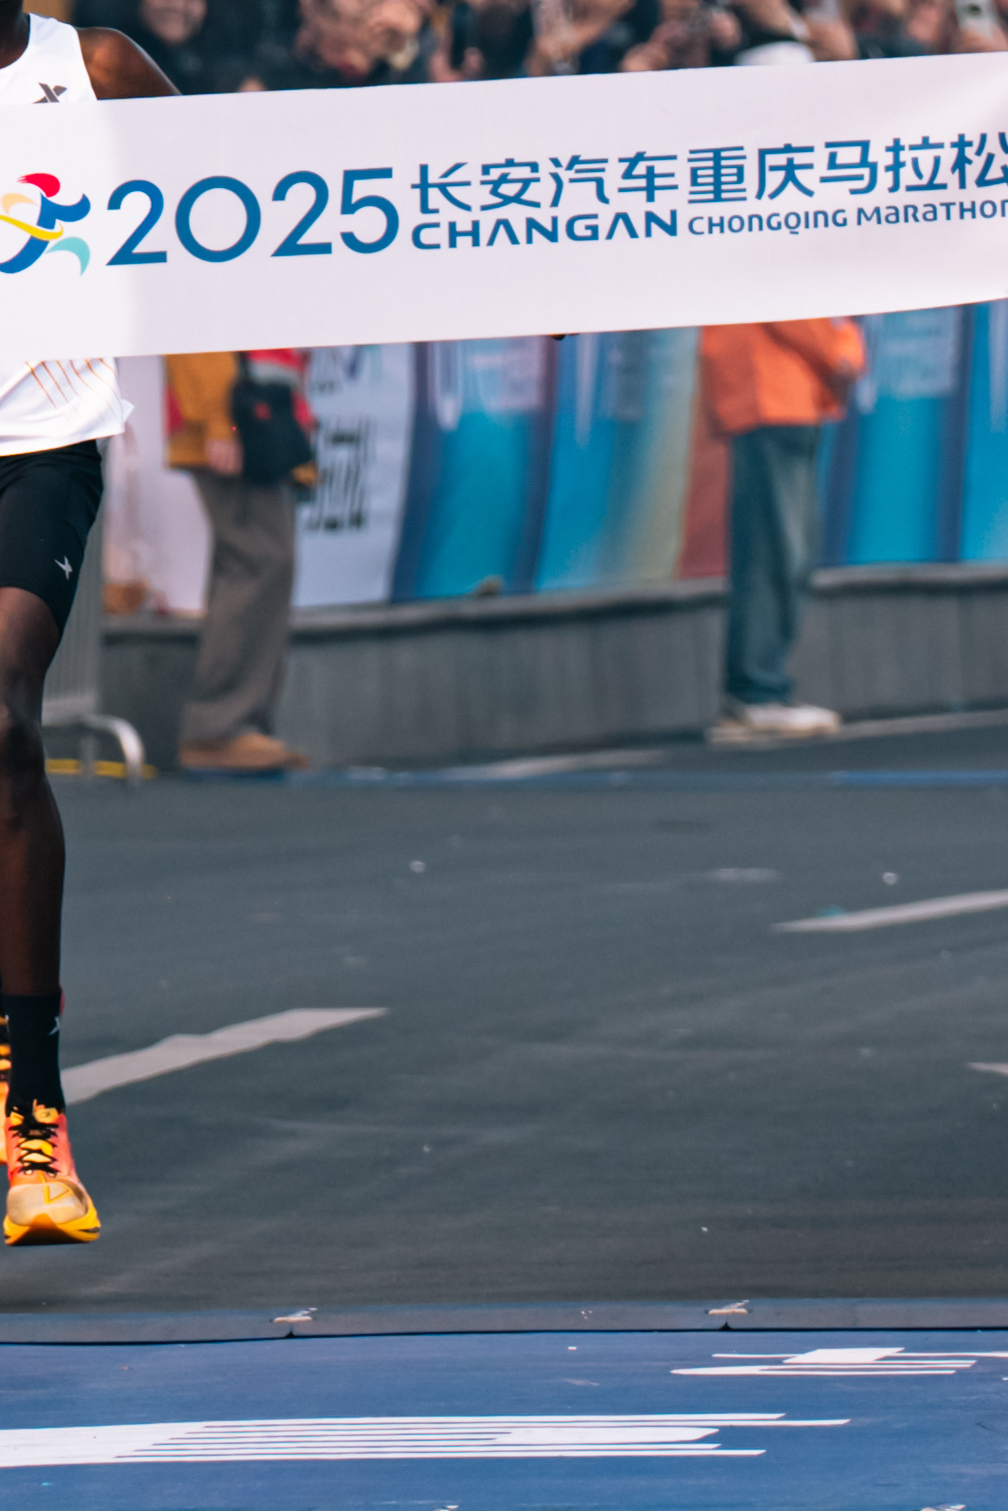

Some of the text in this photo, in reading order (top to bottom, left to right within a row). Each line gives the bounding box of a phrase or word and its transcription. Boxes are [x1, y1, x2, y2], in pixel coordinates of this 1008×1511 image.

[105, 131, 1008, 266] 2025 长安汽车重庆马拉松
[411, 209, 678, 250] CHANGAN
